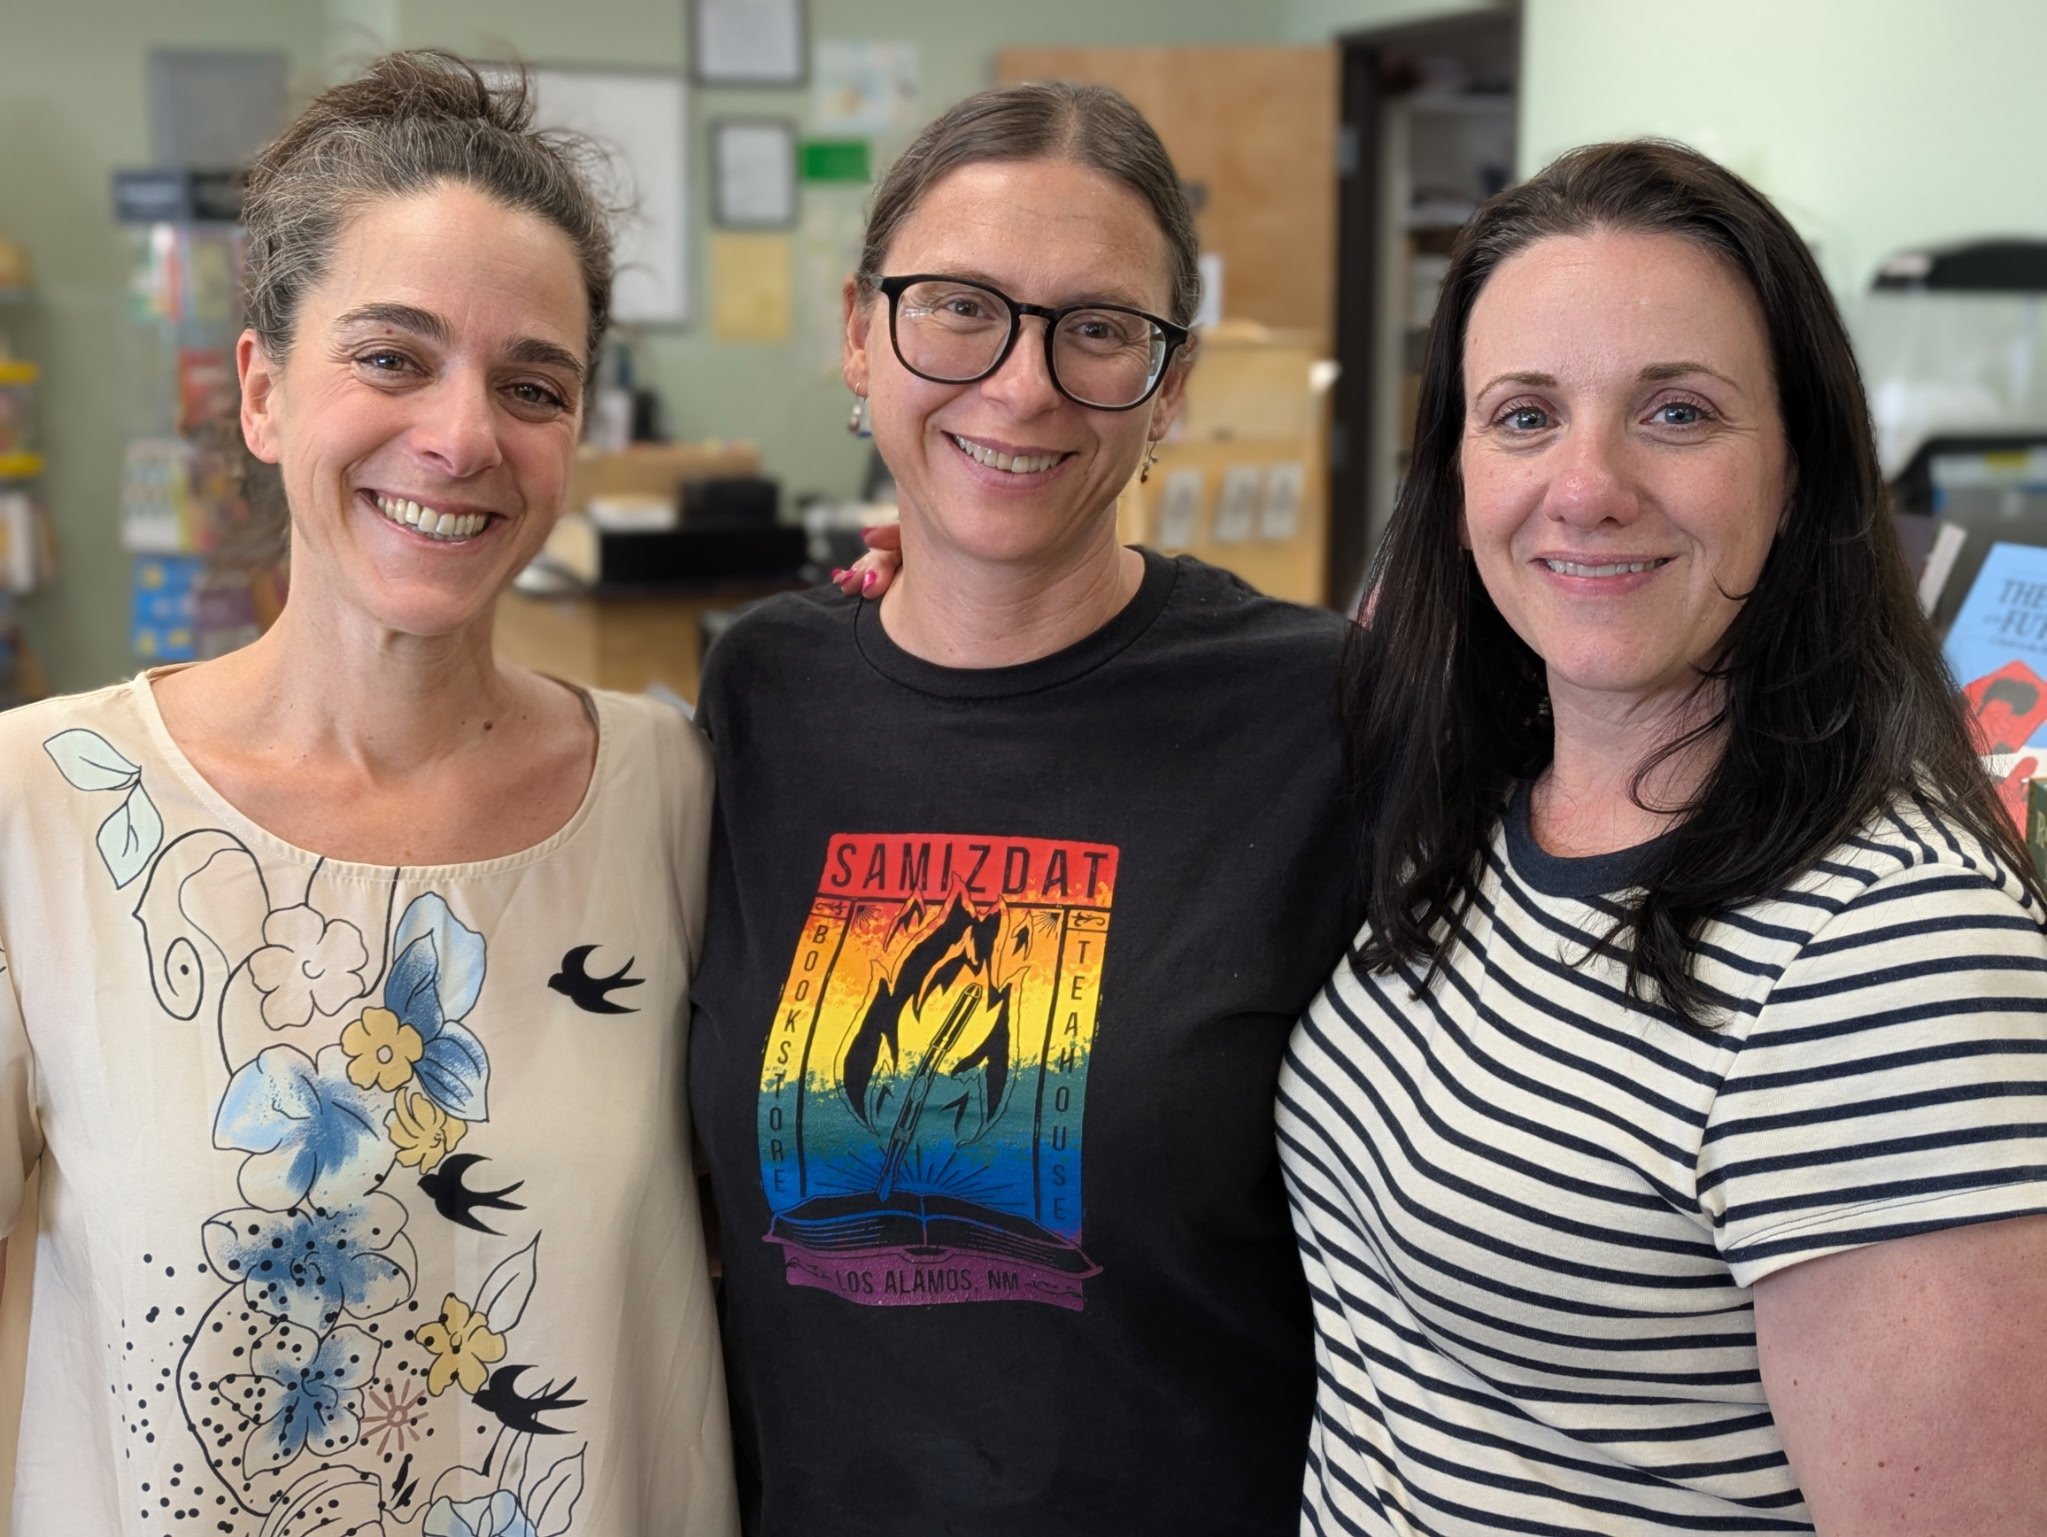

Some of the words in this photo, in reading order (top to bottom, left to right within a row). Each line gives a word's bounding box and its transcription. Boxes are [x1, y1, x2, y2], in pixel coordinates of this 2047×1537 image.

[830, 842, 1108, 899] SAMIZDAT
[769, 925, 829, 1192] BOOKSTORE
[1053, 940, 1090, 1220] TEAHOUSE
[835, 1270, 873, 1293] LOS
[884, 1269, 980, 1294] ALAMOS,
[987, 1270, 1019, 1290] NM
